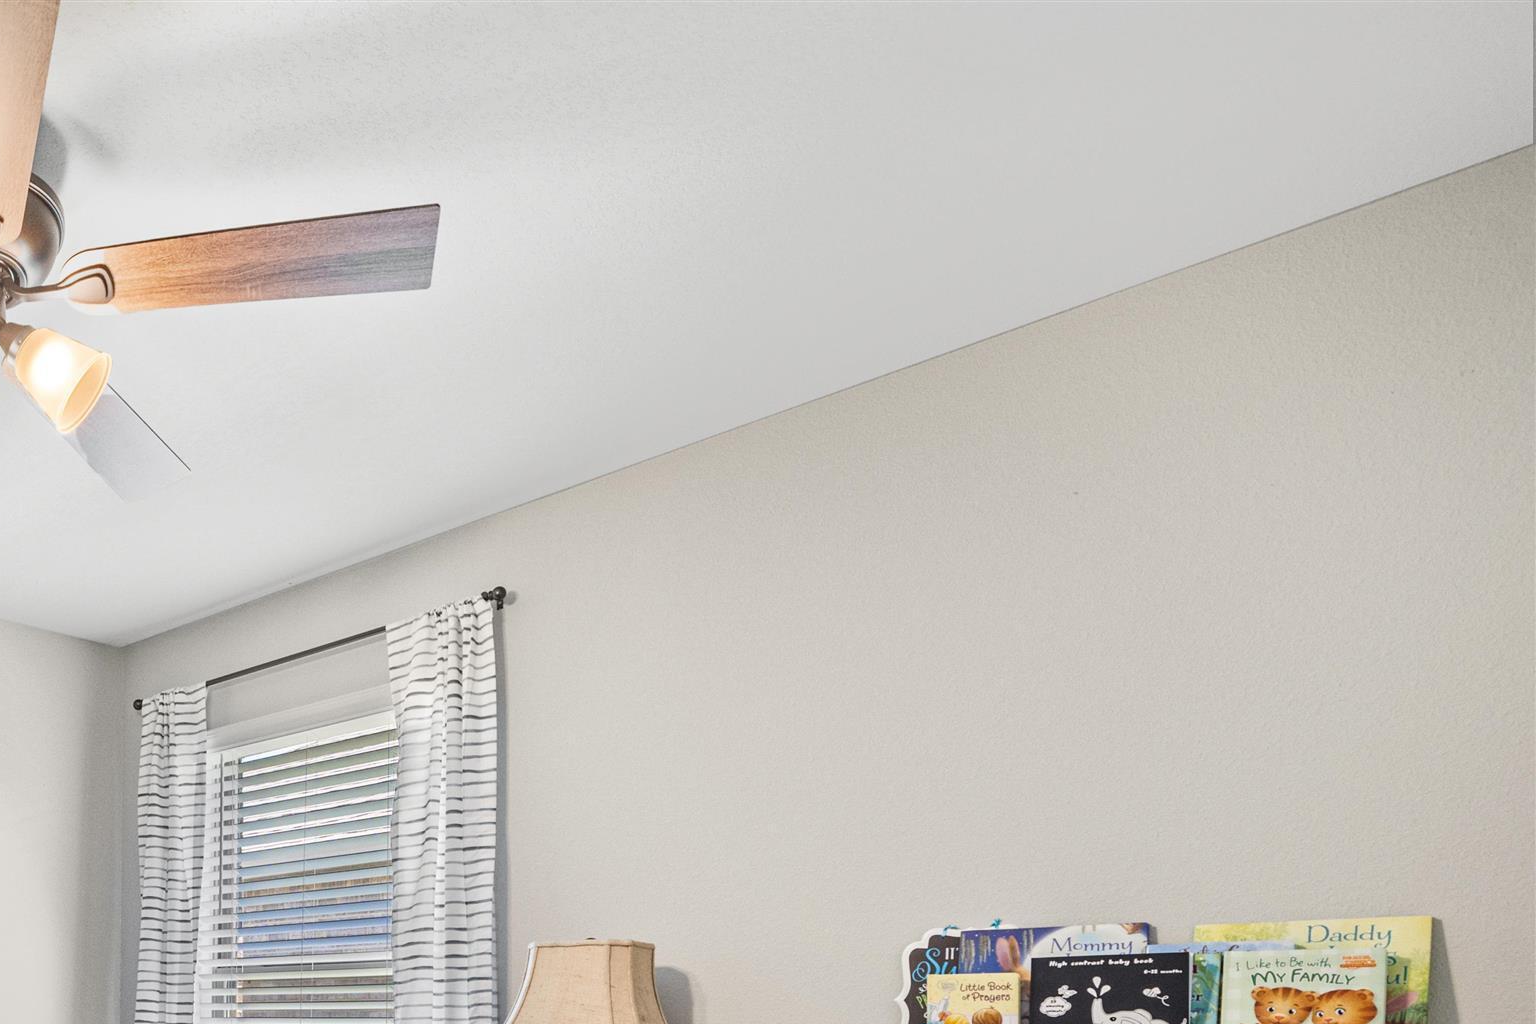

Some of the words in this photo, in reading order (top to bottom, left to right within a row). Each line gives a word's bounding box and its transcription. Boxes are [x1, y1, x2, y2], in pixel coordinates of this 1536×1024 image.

[1307, 924, 1392, 948] Daddy
[1050, 937, 1133, 954] Mommy
[1049, 960, 1068, 969] High
[1070, 959, 1104, 967] contrast
[1108, 959, 1130, 967] baby
[1246, 957, 1271, 971] Like
[1275, 958, 1285, 968] to
[1290, 956, 1304, 968] Be
[1307, 957, 1332, 968] with
[1251, 969, 1286, 986] MY
[1291, 968, 1356, 985] FAMILY
[960, 983, 986, 992] Little
[987, 981, 1013, 991] Book
[971, 992, 1011, 1003] Prayers
